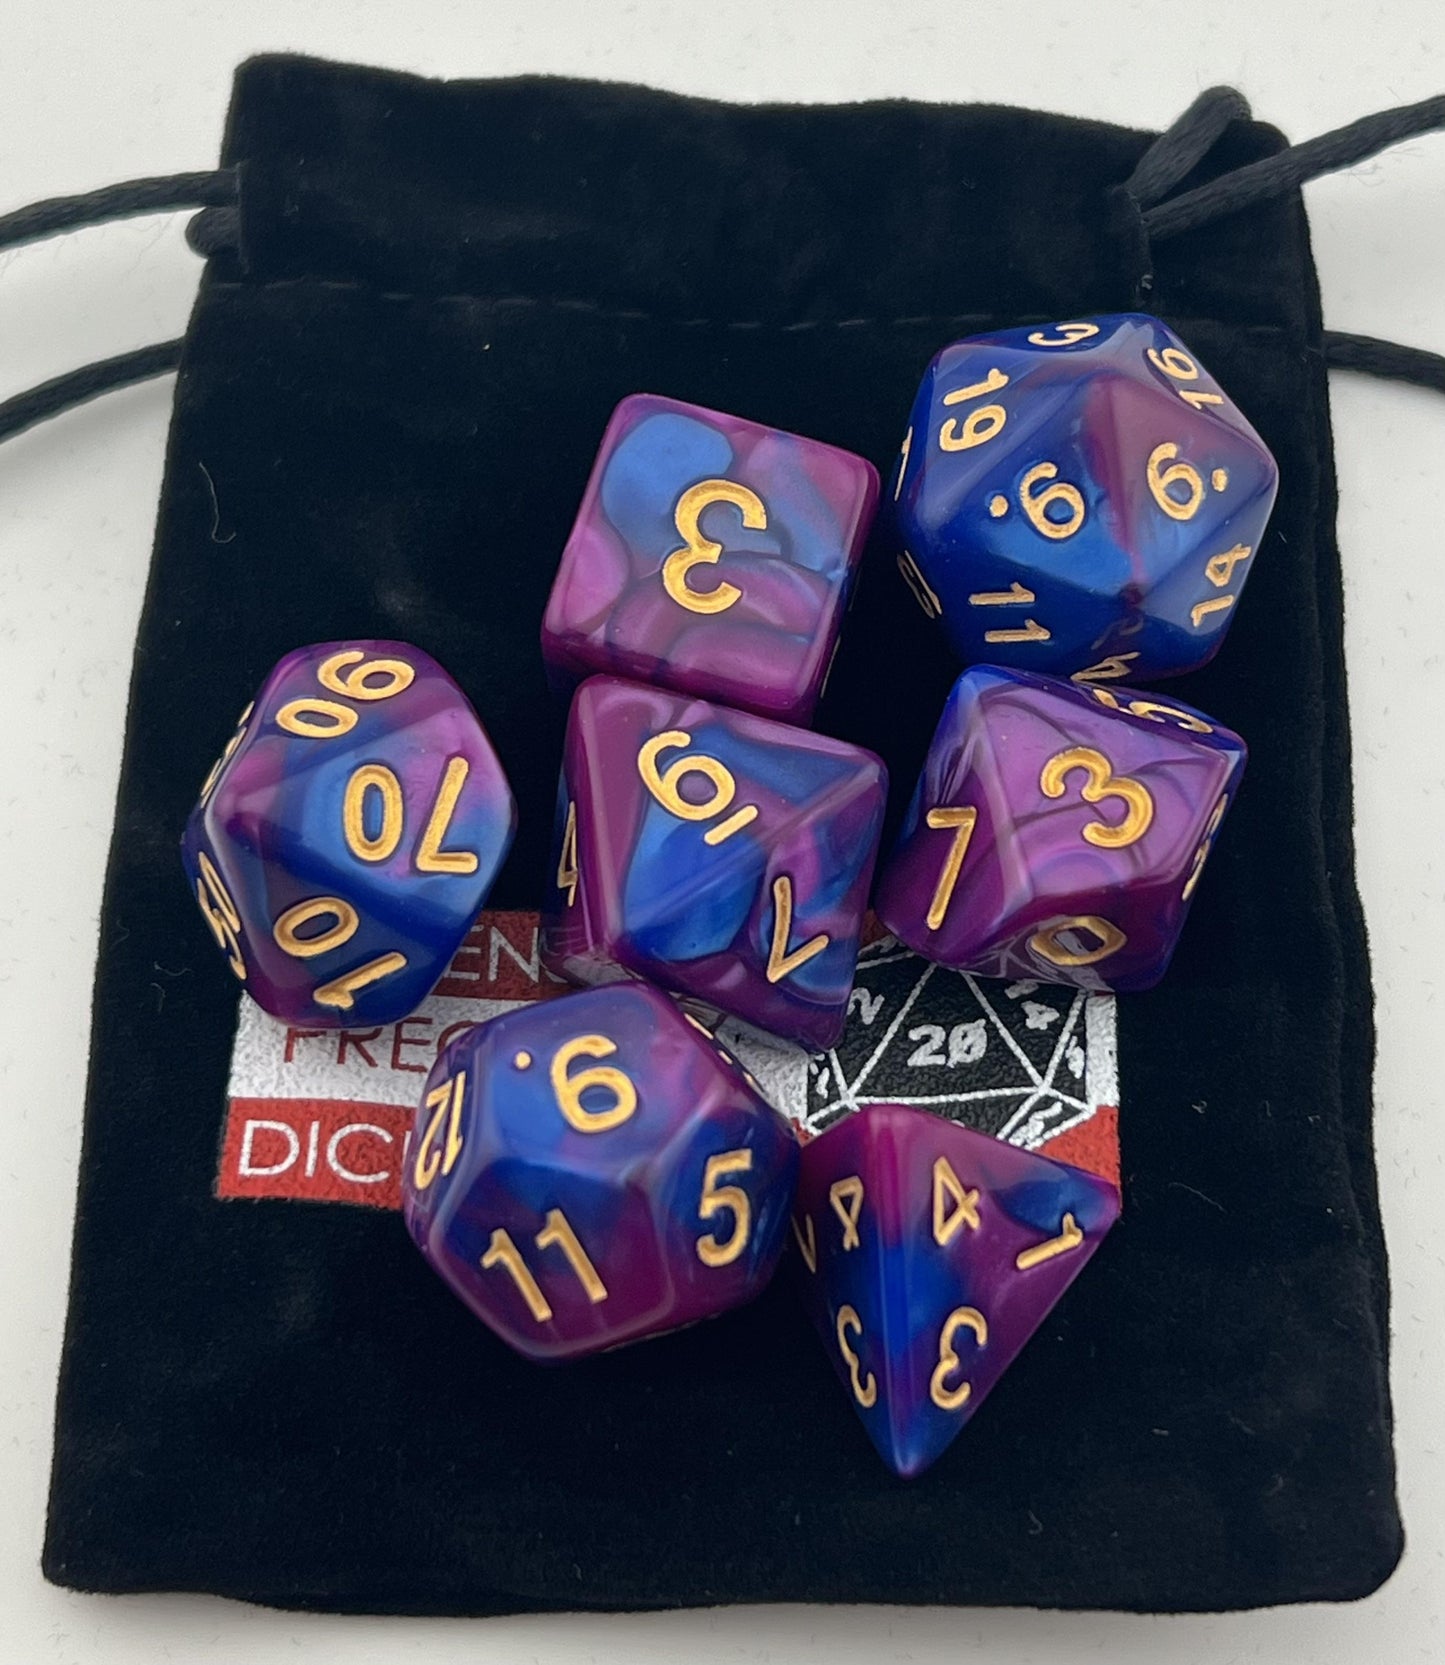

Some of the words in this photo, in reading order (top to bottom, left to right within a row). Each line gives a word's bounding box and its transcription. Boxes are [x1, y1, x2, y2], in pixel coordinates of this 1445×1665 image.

[1028, 322, 1100, 346] 3
[940, 367, 1009, 452] 19
[662, 479, 767, 614] 3
[1190, 543, 1251, 627] 14
[968, 582, 1051, 643] 11
[342, 756, 479, 873] 70
[1040, 747, 1154, 848] 3
[926, 805, 977, 930] 7
[273, 896, 407, 1010] 10
[766, 876, 829, 983] 7
[1030, 915, 1127, 966] 0
[239, 1119, 411, 1184] DIC
[415, 1071, 466, 1190] 12
[696, 1148, 753, 1268] 5
[933, 1156, 981, 1246] 4
[1016, 1212, 1084, 1271] 1
[480, 1208, 608, 1323] 11
[836, 1305, 877, 1408] 3
[930, 1306, 988, 1410] 3
